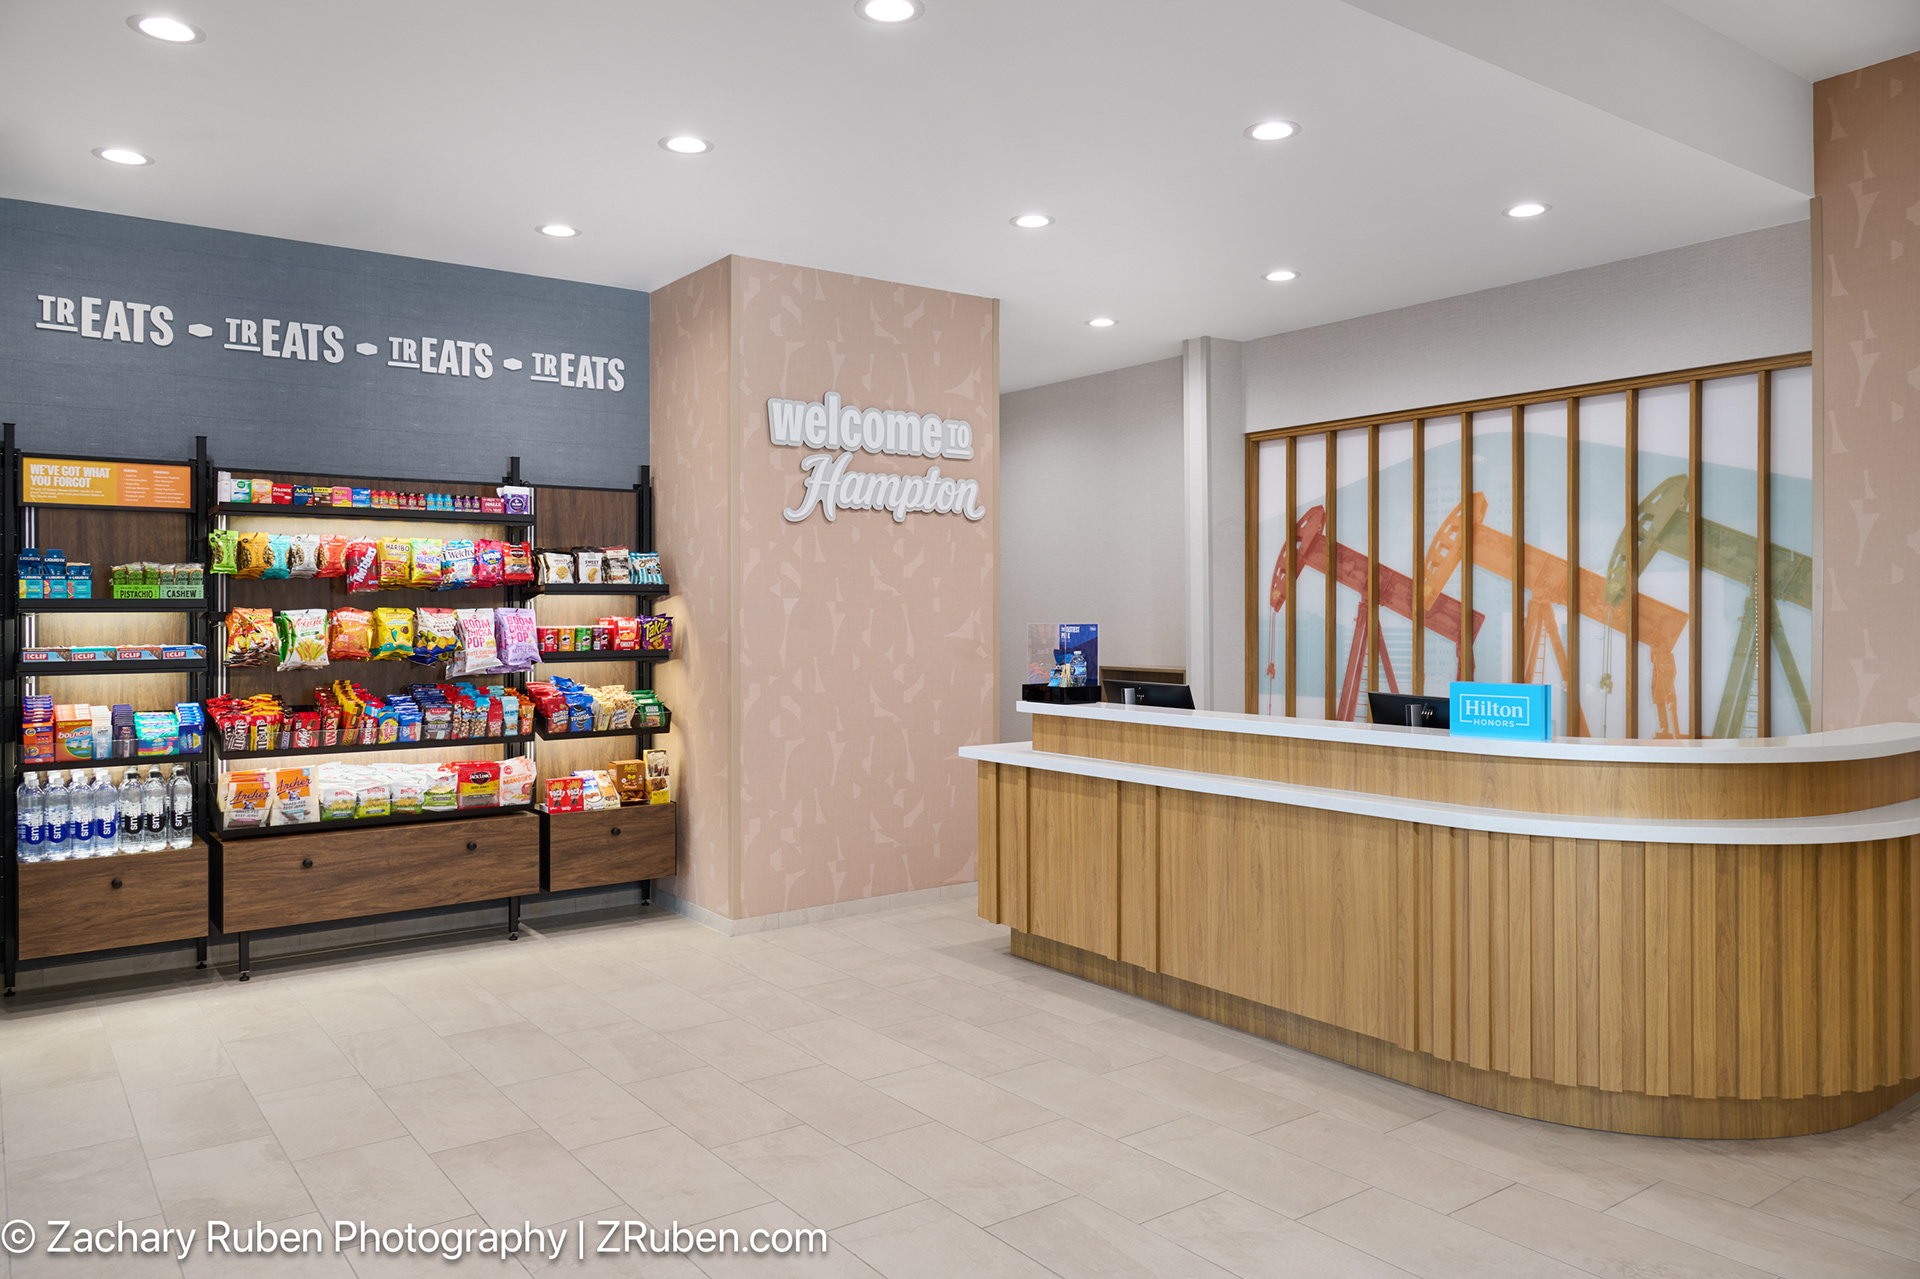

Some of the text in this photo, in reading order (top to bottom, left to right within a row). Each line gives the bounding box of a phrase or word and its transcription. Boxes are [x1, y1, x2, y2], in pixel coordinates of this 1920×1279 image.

[35, 294, 626, 392] TREATS TREATS TREATS TREATS
[769, 393, 972, 457] welcome TO
[29, 463, 111, 478] WE'VE GOT WHAT
[30, 475, 92, 488] YOU FORGOT
[784, 452, 985, 521] Hampton
[385, 543, 410, 552] HARIBO
[120, 590, 153, 599] PISTACHIO
[166, 589, 197, 598] CASHEW
[462, 619, 491, 629] BOOM
[506, 615, 534, 626] BOOM
[508, 623, 536, 633] CHICKA
[643, 619, 669, 641] Takis
[467, 636, 486, 649] POP
[510, 632, 529, 643] POP
[30, 652, 47, 660] CLIF
[77, 652, 95, 660] CLIF
[1465, 700, 1523, 718] Hilton
[1474, 718, 1515, 728] HONORS
[57, 729, 91, 740] bounce
[276, 776, 312, 794] Archer
[230, 788, 271, 804] Archer
